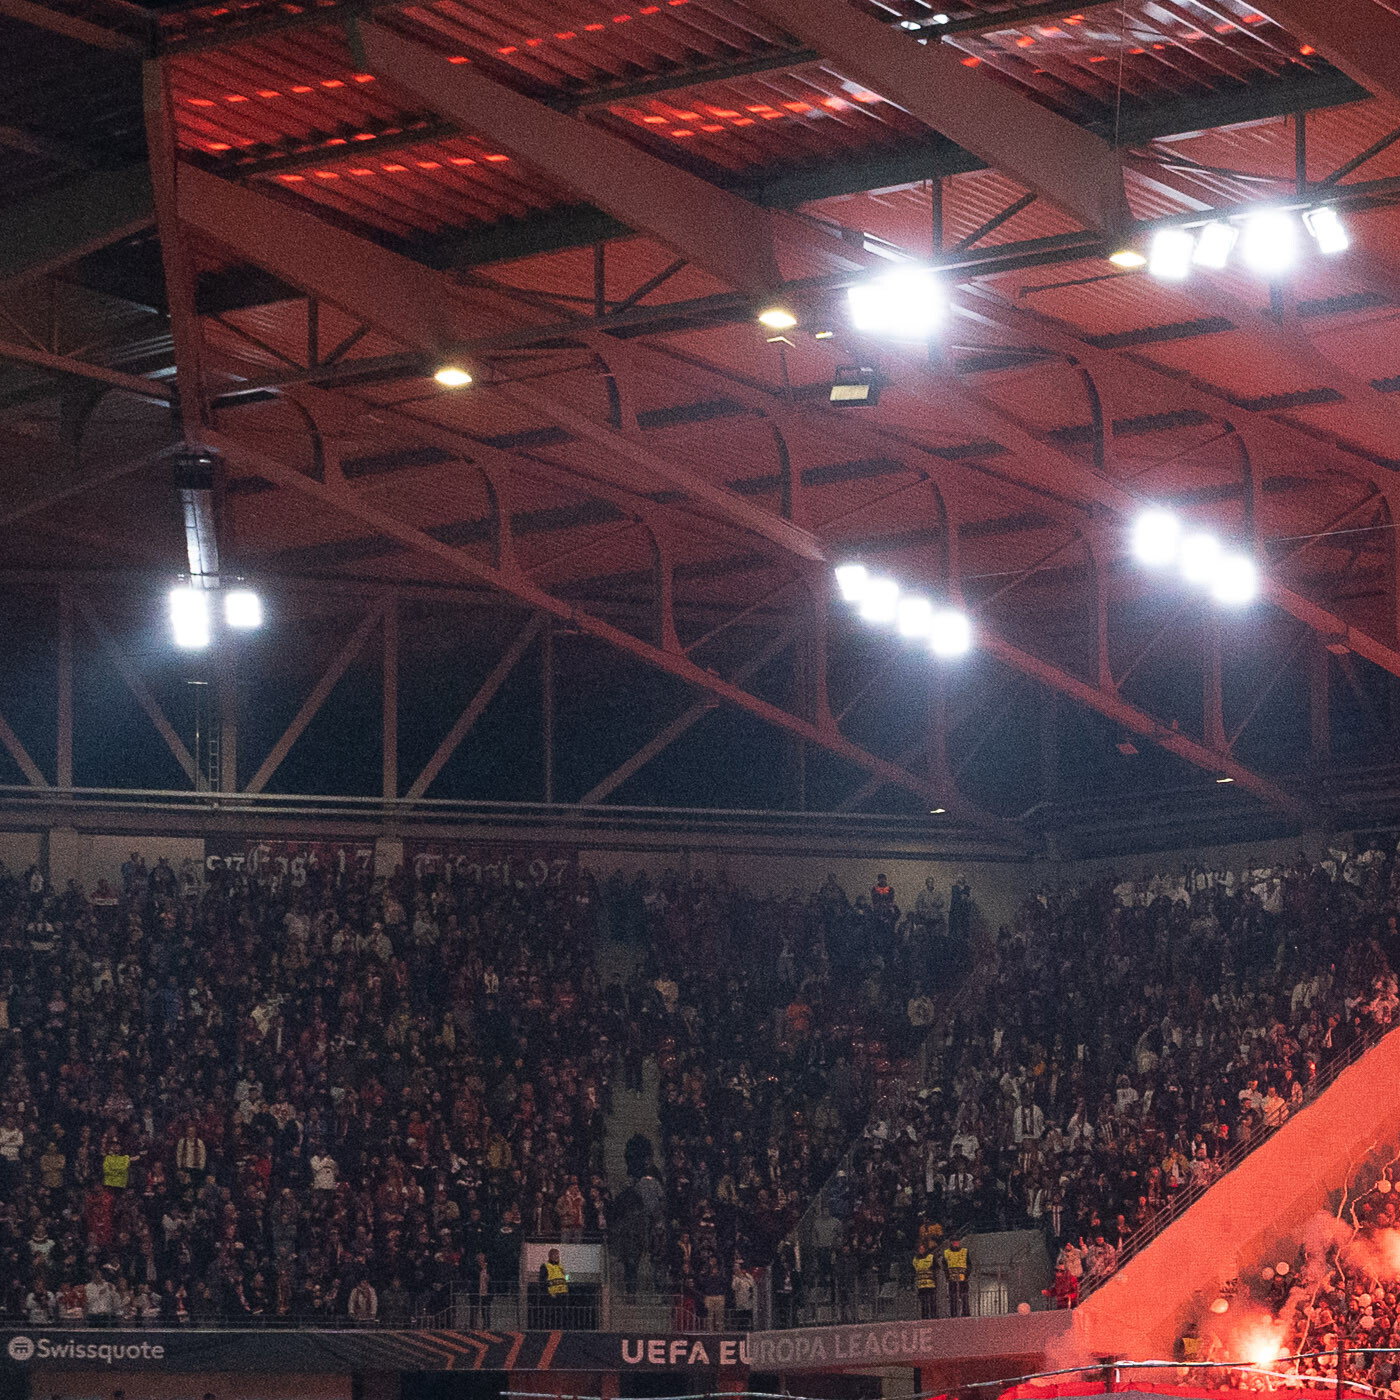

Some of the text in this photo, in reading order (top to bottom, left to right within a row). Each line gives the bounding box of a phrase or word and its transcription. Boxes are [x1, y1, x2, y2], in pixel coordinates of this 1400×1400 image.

[37, 1338, 165, 1364] Swissquote
[621, 1327, 934, 1365] UEFA EUROPA LEAGUE
